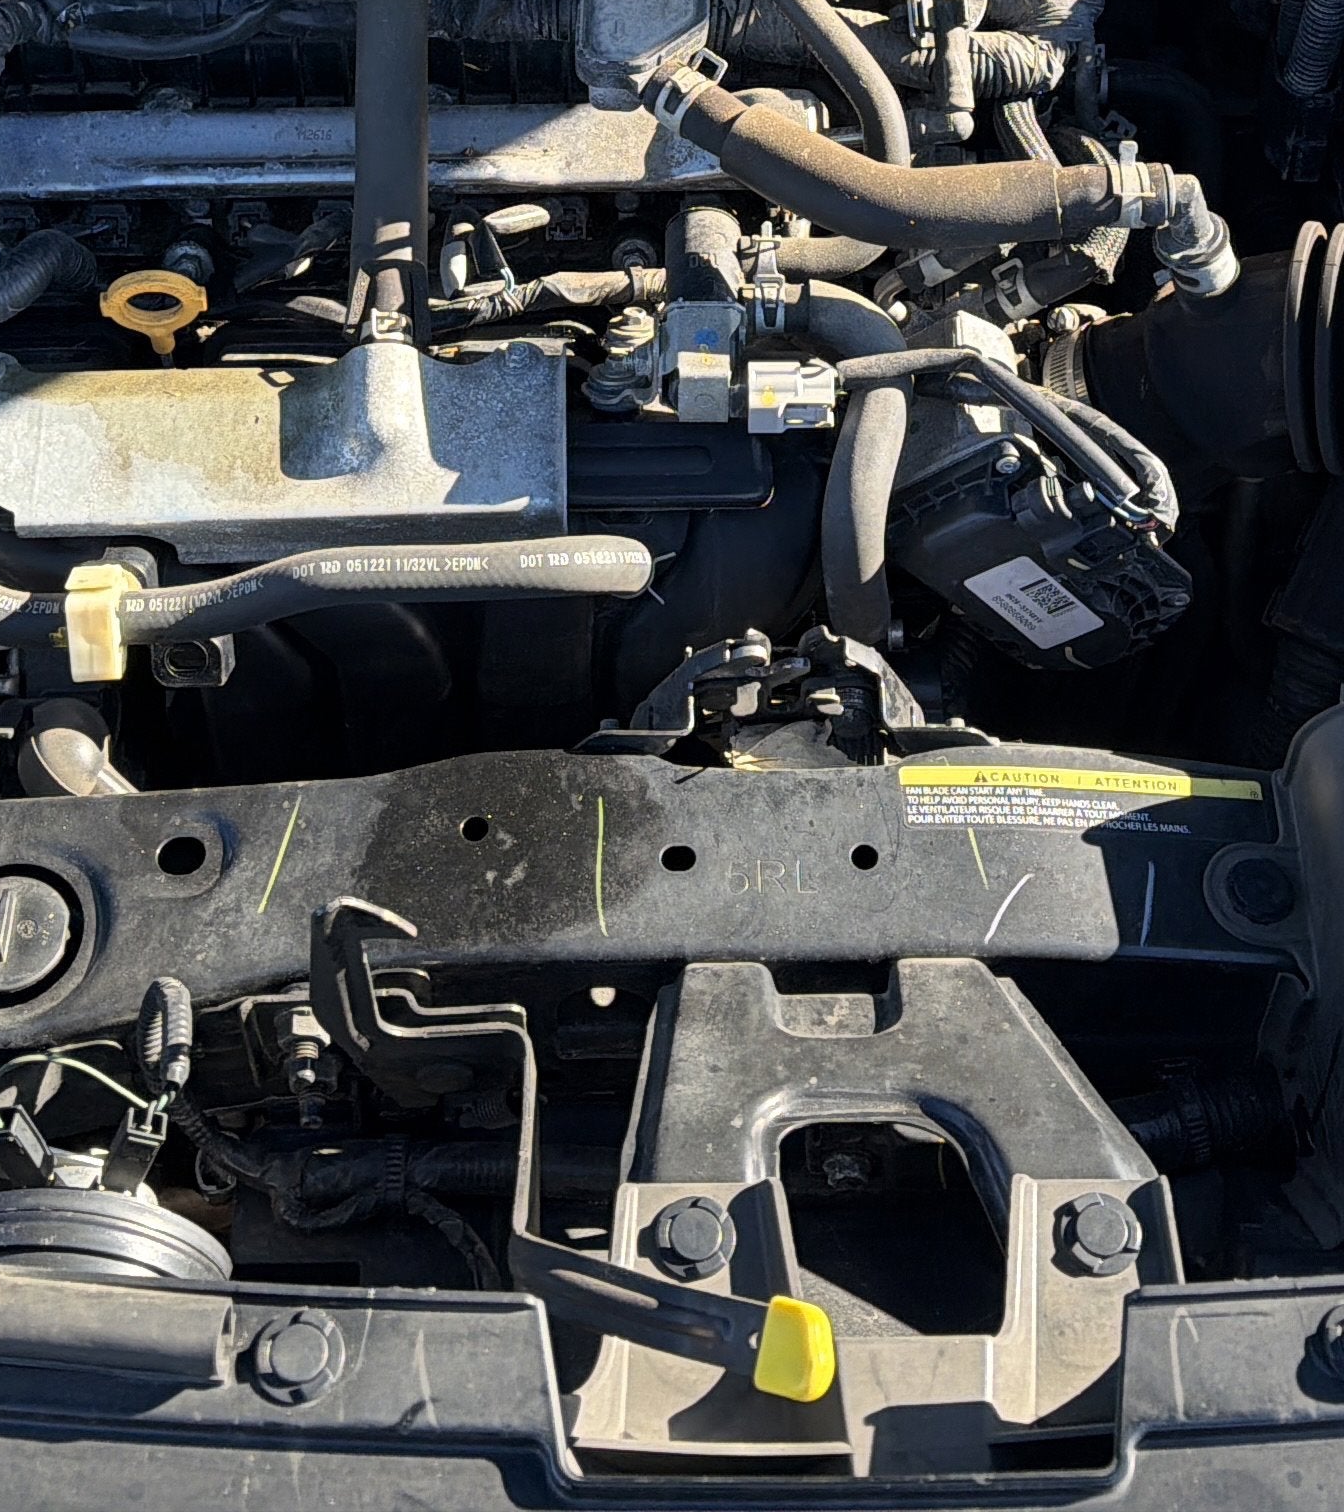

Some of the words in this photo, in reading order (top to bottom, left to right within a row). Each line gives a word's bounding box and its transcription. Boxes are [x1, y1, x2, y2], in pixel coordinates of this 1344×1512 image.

[292, 562, 316, 580] DOT
[346, 557, 392, 574] 051221
[519, 553, 544, 569] DOT
[25, 601, 60, 615] >EPDM
[149, 597, 187, 613] 051221
[990, 771, 1060, 785] CAUTION
[1094, 777, 1178, 792] ATTENTION
[923, 787, 950, 795] BLADE
[950, 787, 968, 795] CAN
[969, 787, 993, 796] START
[994, 787, 1005, 796] AT
[1006, 788, 1024, 796] ANY
[907, 796, 919, 804] TO
[920, 796, 940, 804] HELP
[942, 796, 967, 805] AVOID
[968, 796, 1009, 805] PERSONAL
[1041, 798, 1061, 807] KEEP
[1061, 799, 1091, 809] HANDS
[907, 805, 918, 814] LE
[918, 805, 977, 815] VENTILATEUR
[979, 806, 1011, 815] RISQUE
[1012, 806, 1025, 815] DE
[1083, 809, 1106, 818] TOUT
[908, 815, 934, 824] POUR
[966, 815, 995, 824] TOUTE
[1043, 817, 1056, 826] NE
[1057, 817, 1073, 827] PAS
[1074, 818, 1088, 827] EN
[1142, 823, 1158, 832] LES
